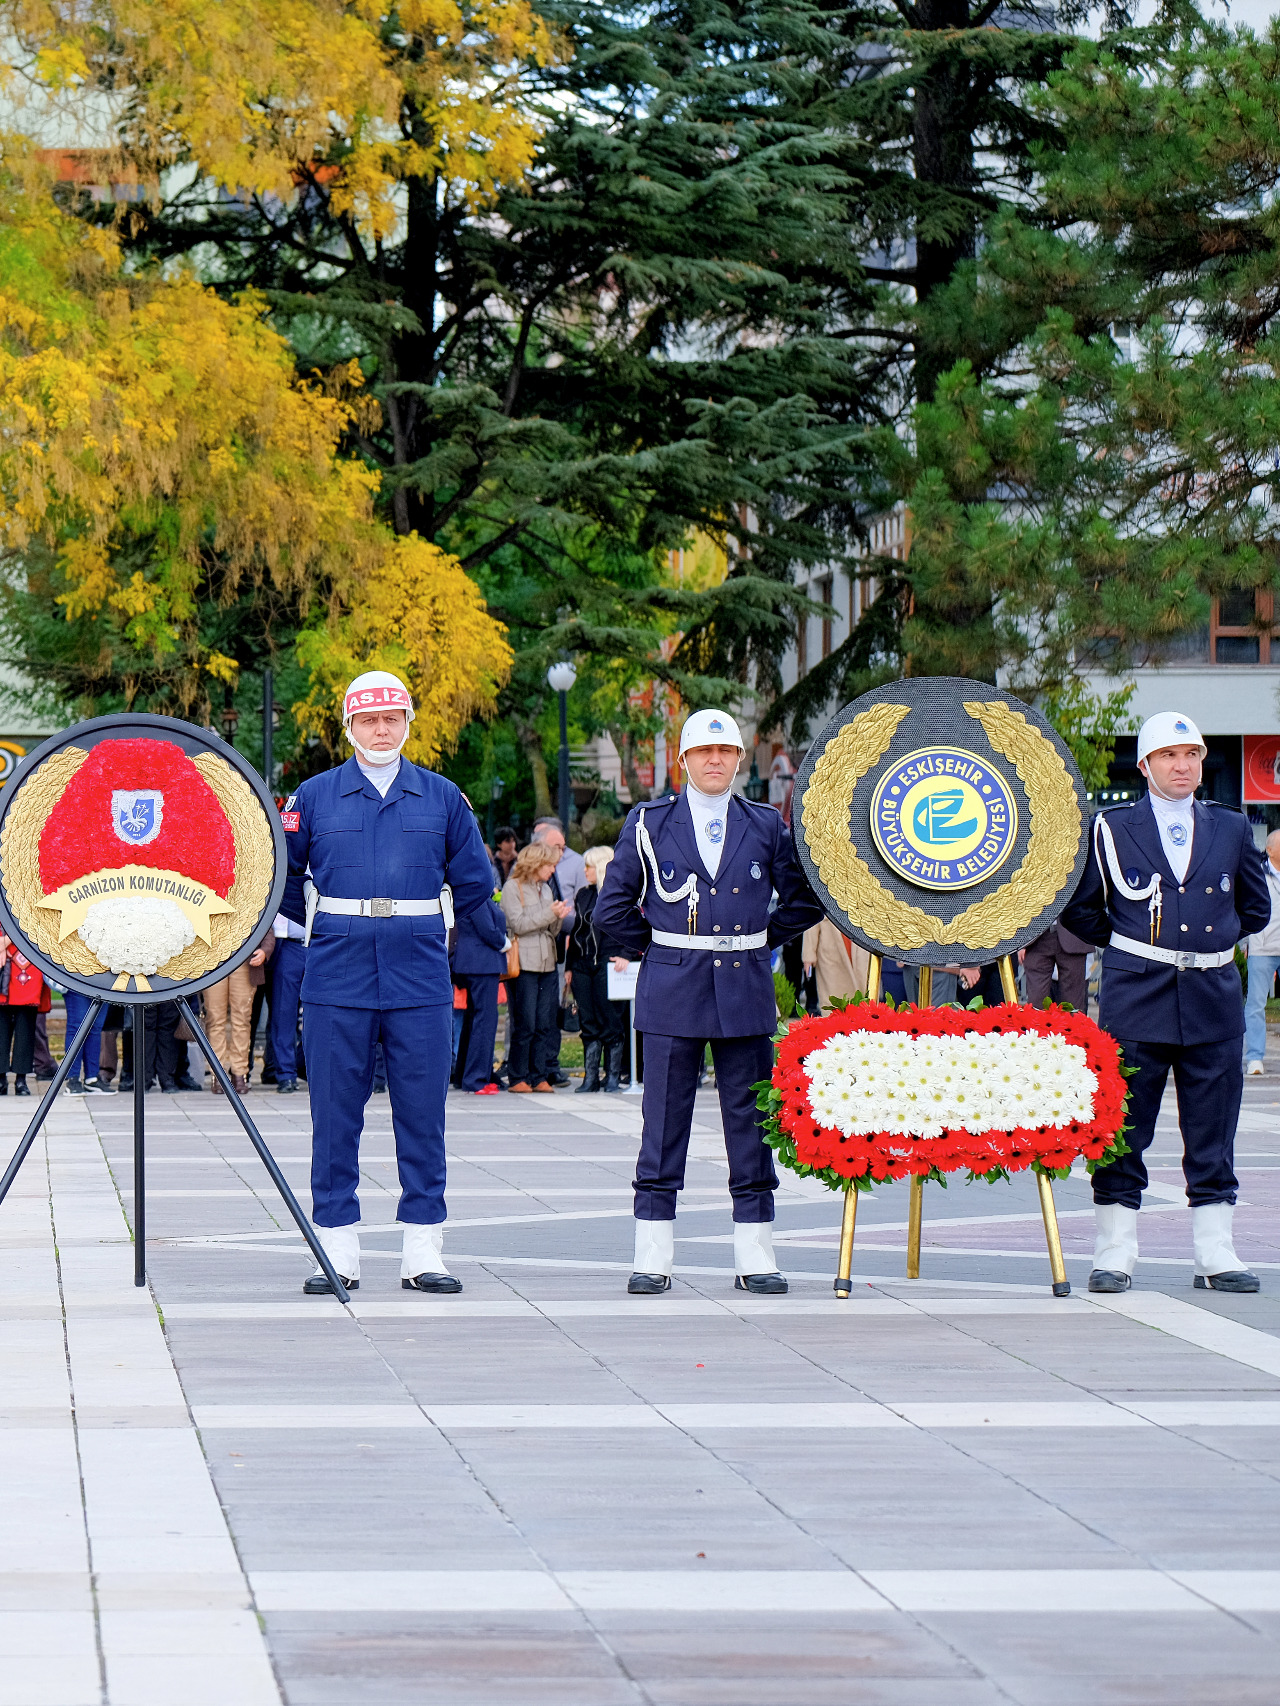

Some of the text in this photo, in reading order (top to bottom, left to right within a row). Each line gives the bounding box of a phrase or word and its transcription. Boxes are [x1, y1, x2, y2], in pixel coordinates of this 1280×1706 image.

[898, 756, 983, 787] ESKİŞEHİR
[881, 797, 1006, 880] BÜYÜKŞEHİR BELEDİYESİ
[68, 875, 207, 907] GARNİZON KOMUTANLIĞI
